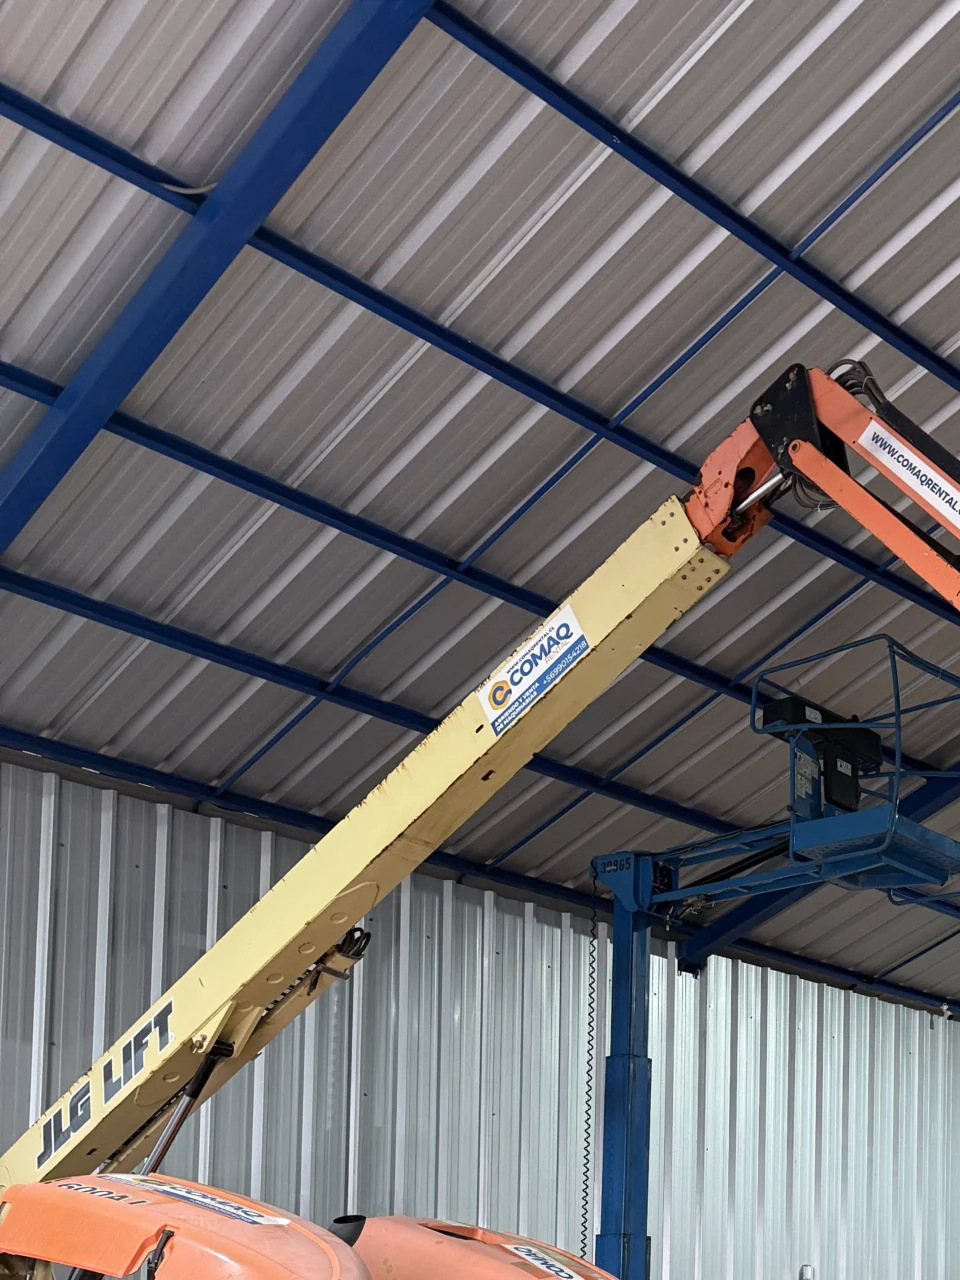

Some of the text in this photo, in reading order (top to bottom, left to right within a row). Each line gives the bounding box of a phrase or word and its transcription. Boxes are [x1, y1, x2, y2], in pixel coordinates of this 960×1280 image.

[509, 622, 574, 687] COMAQ
[543, 640, 587, 685] +56990154218
[544, 640, 571, 665] RENTAL
[494, 701, 519, 728] ARRIENDO
[523, 682, 540, 699] VENTA
[36, 997, 174, 1172] JLG LIFT
[513, 1246, 575, 1280] COMAQ
